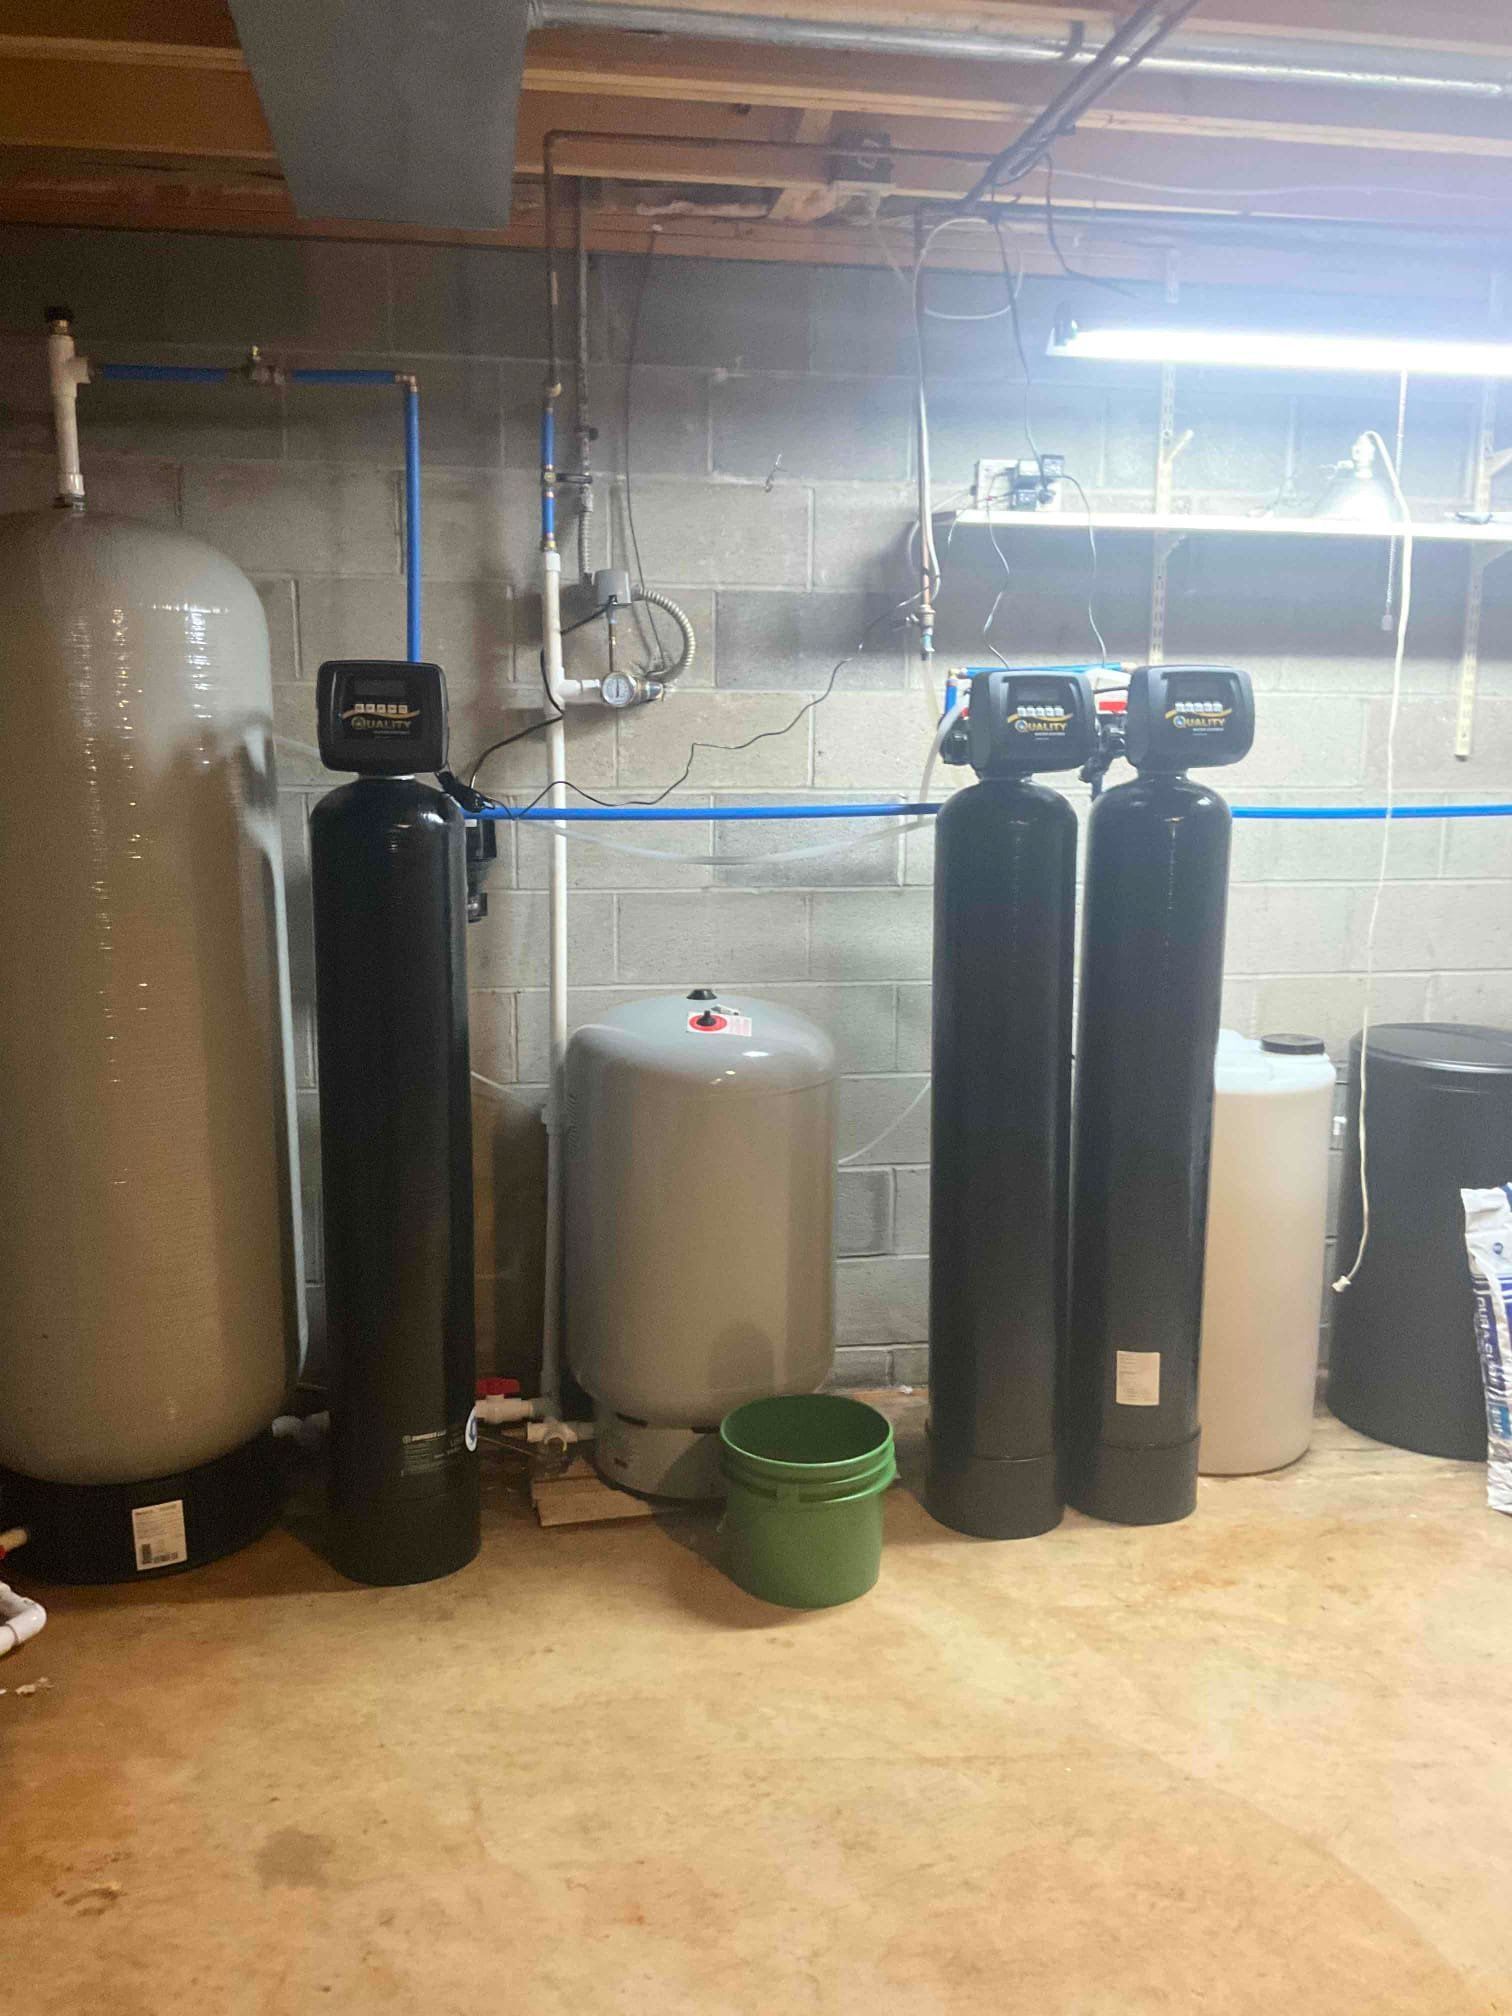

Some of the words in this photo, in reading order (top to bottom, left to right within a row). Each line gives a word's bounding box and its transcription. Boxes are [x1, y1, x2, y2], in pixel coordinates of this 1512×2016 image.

[351, 716, 412, 730] QUALITY
[1015, 719, 1067, 733] QUALITY
[1173, 715, 1225, 728] QUALITY
